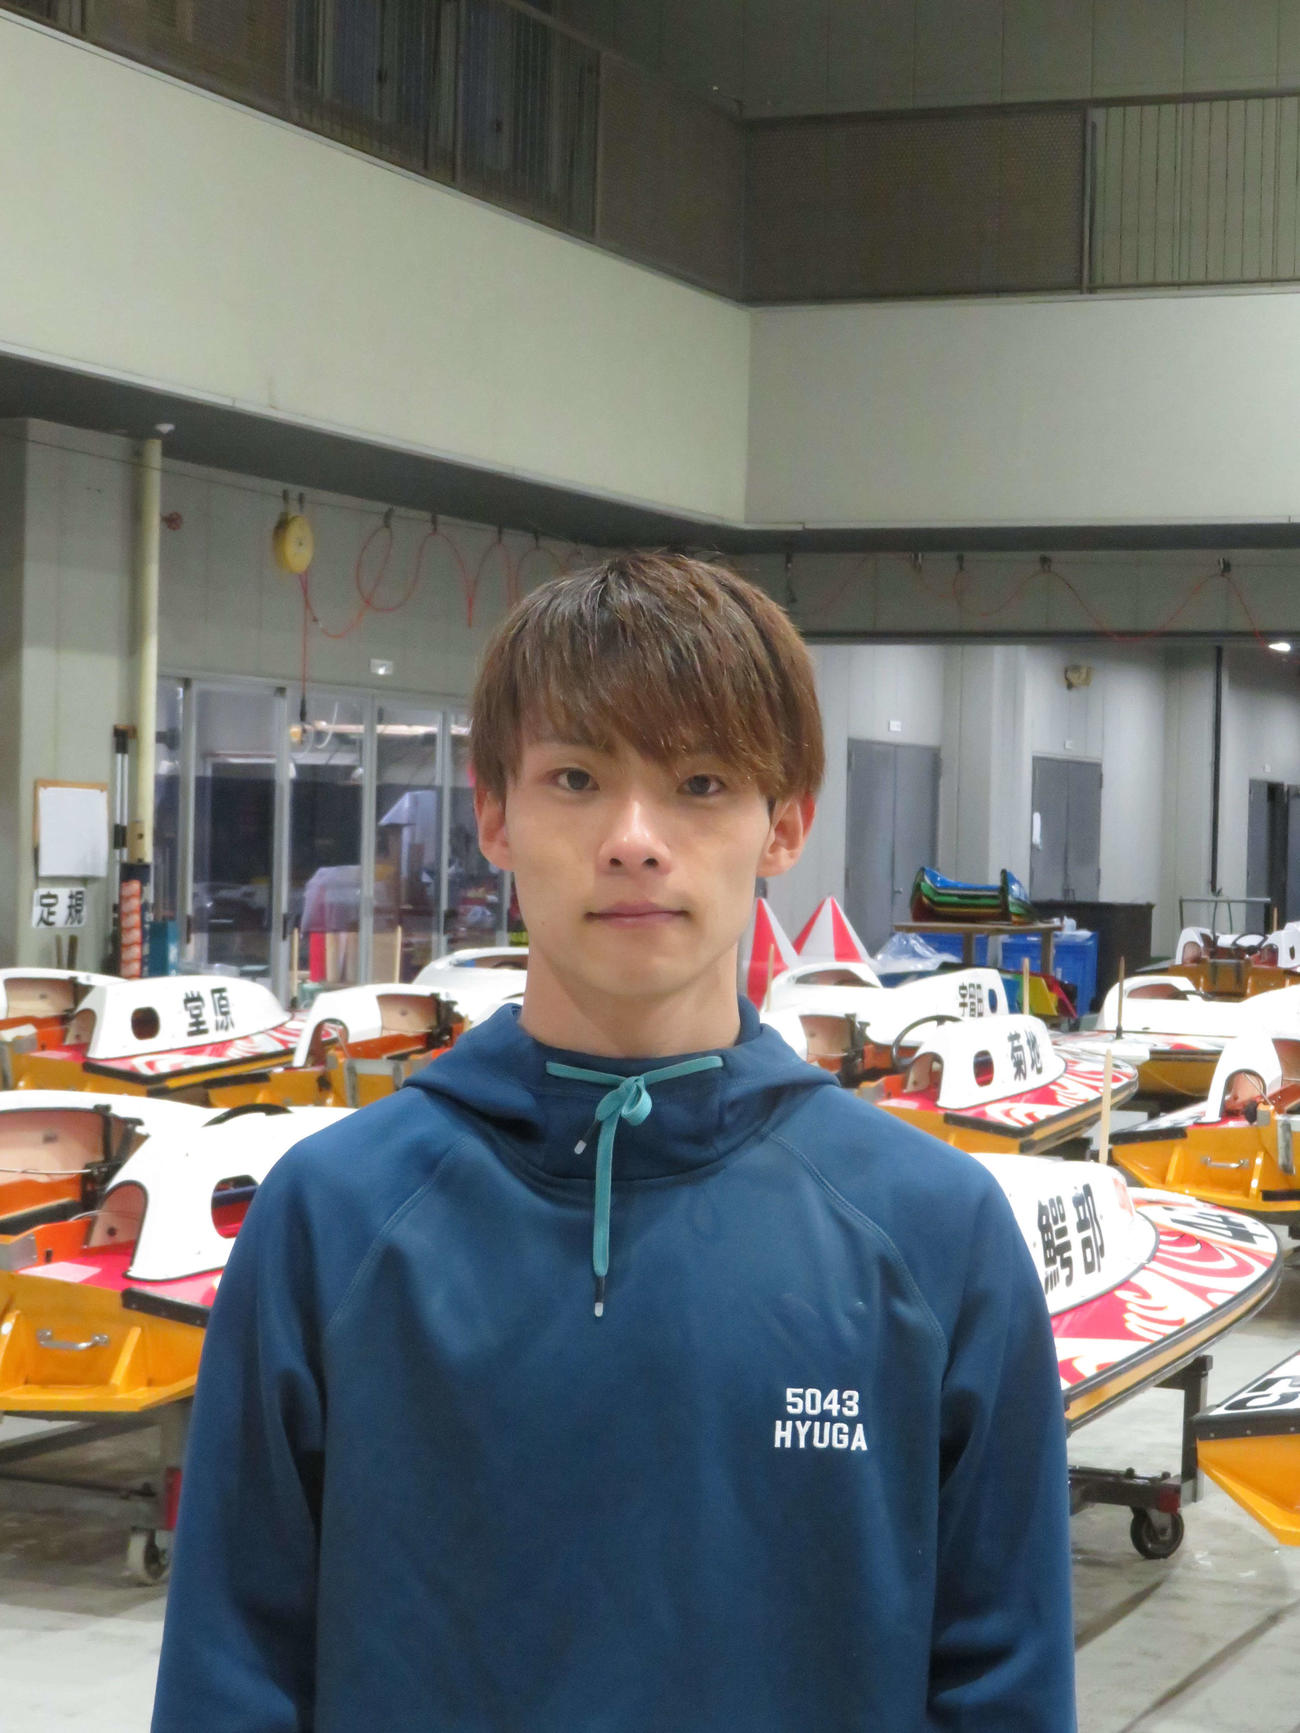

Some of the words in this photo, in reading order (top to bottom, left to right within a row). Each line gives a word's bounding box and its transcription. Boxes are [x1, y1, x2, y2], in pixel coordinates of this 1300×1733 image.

[37, 891, 84, 927] 定規
[183, 986, 235, 1037] 堂原
[785, 1387, 860, 1417] 5043
[774, 1420, 868, 1451] HYUGA
